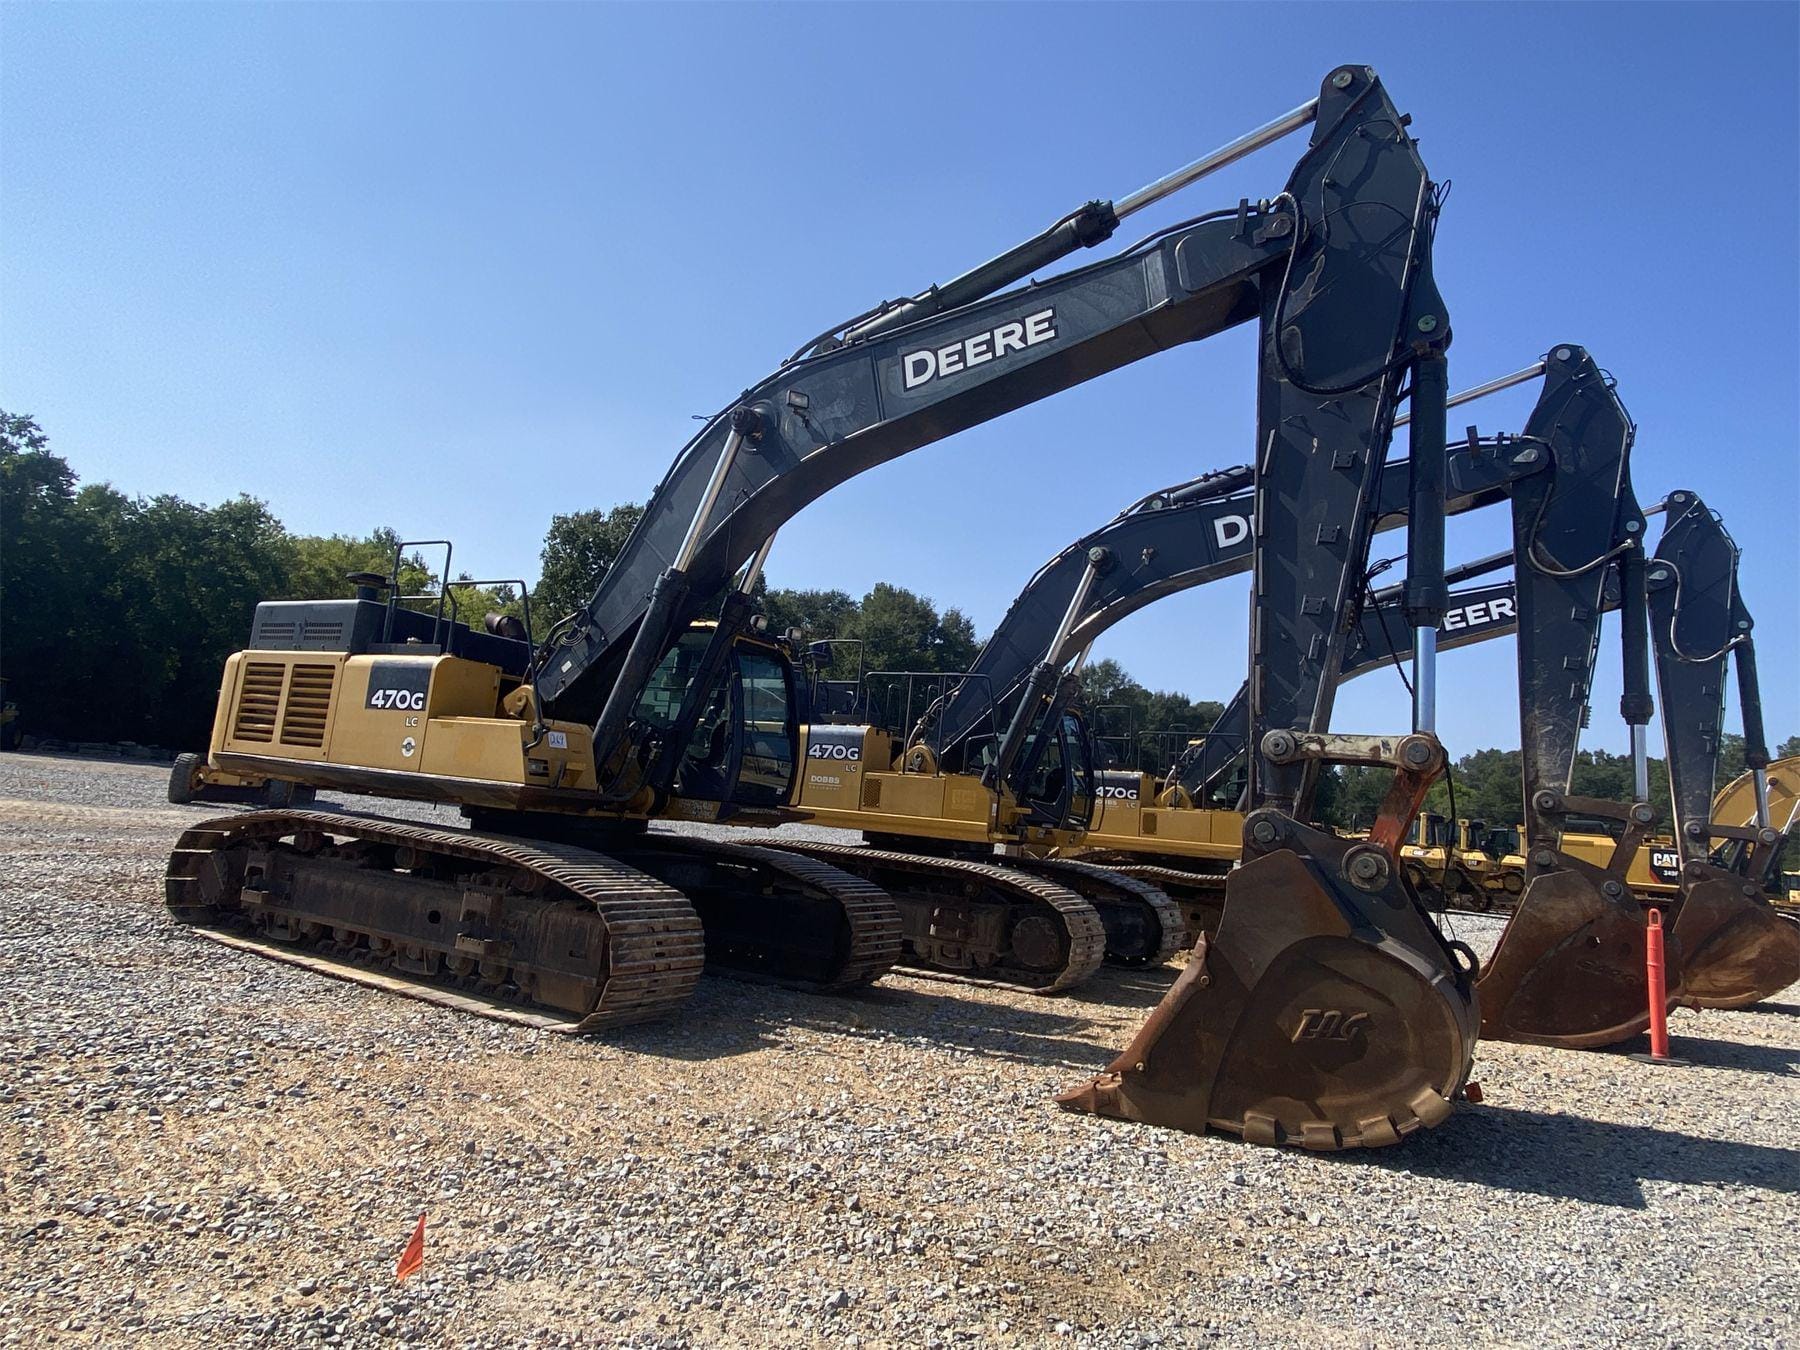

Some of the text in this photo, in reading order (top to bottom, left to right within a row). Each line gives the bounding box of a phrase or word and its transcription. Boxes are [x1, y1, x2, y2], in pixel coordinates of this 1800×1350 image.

[903, 308, 1056, 389] DEERE
[1436, 595, 1516, 632] EER
[370, 689, 424, 710] 470G
[405, 716, 418, 727] LC
[808, 744, 859, 760] 470G
[845, 764, 857, 772] LC
[810, 775, 840, 784] DOBBS
[1095, 786, 1138, 800] 470G
[1653, 852, 1679, 868] CAT
